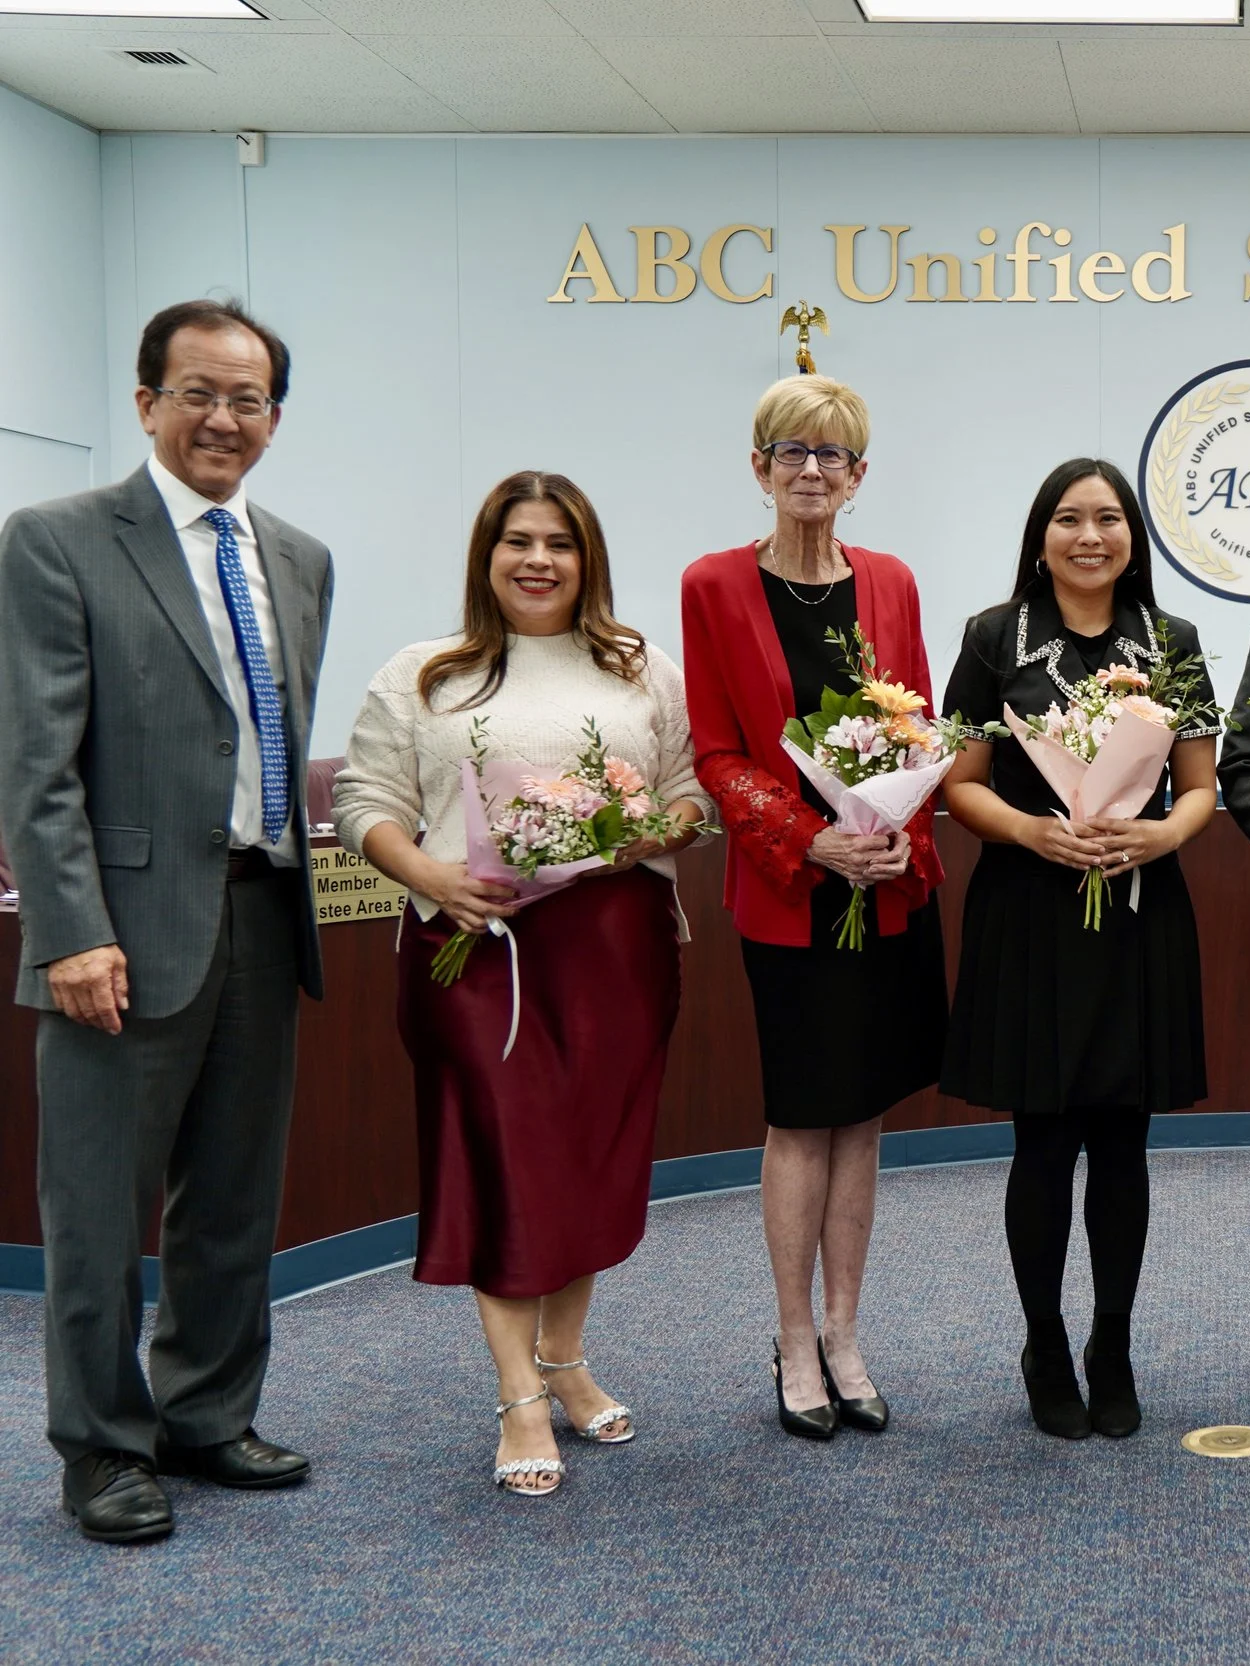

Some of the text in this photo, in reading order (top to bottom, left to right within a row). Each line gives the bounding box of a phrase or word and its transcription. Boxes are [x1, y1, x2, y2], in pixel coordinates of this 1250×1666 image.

[547, 221, 774, 304] ABC
[824, 222, 1193, 304] Unified
[1190, 416, 1239, 465] UNIFIED
[1185, 469, 1198, 502] ABC
[317, 875, 379, 894] Member
[356, 899, 392, 916] Area
[397, 895, 406, 911] 5
